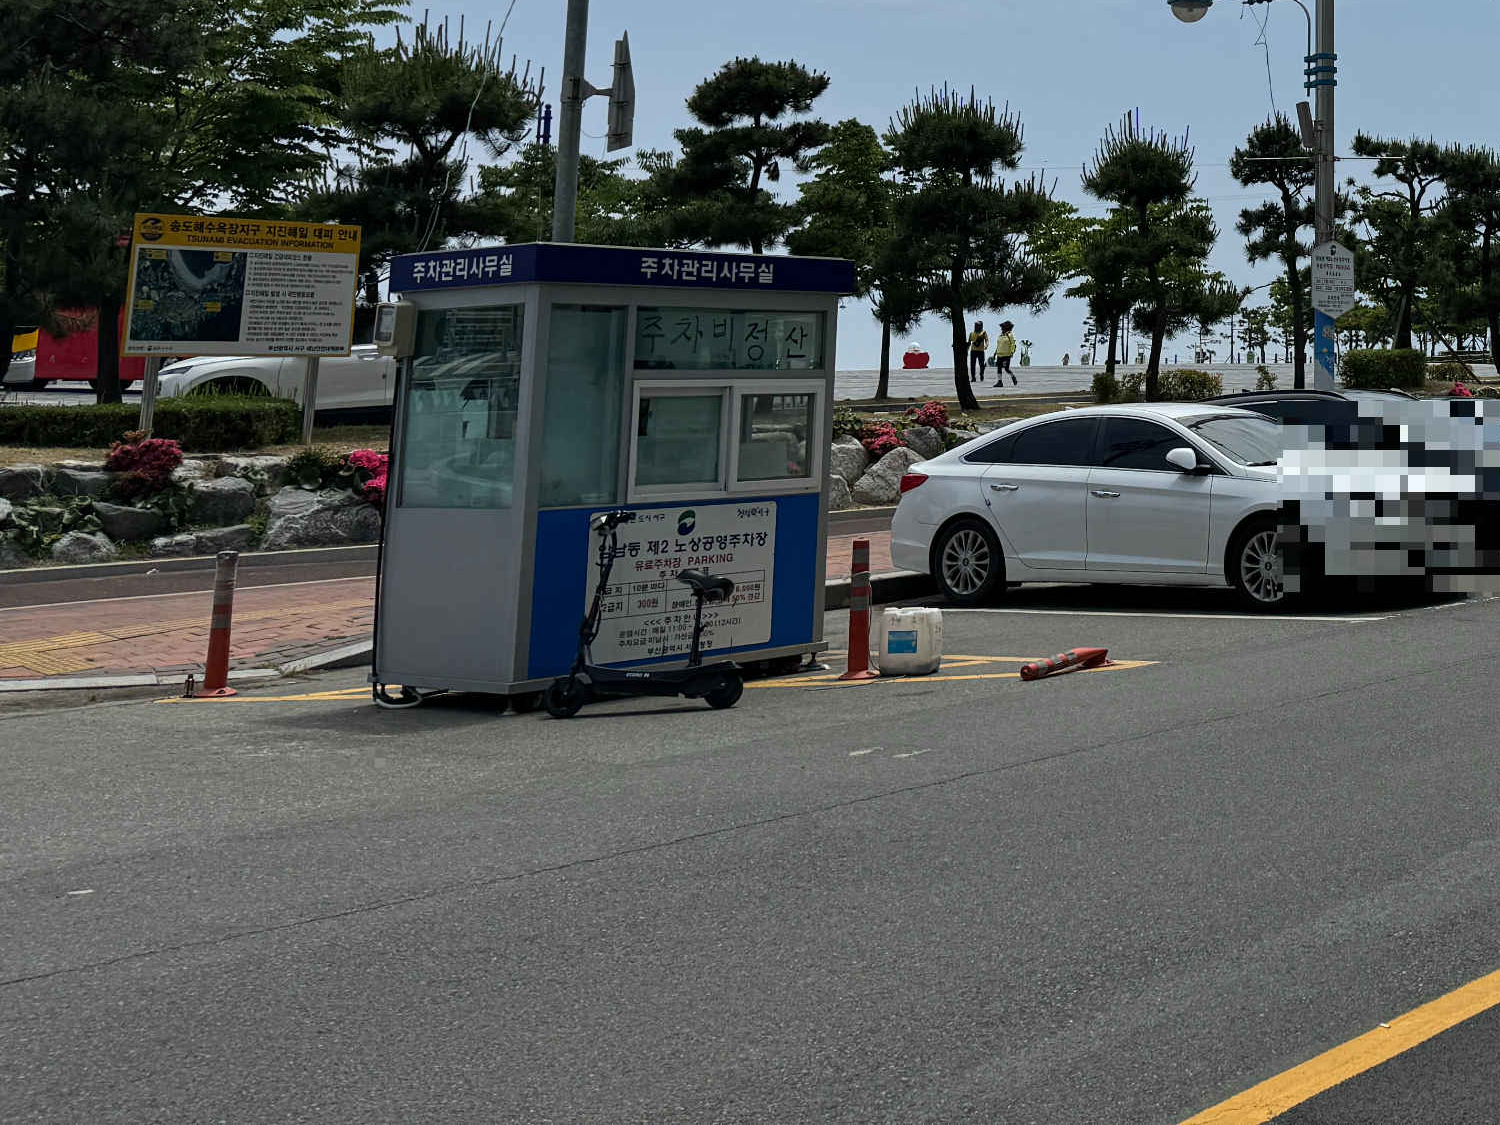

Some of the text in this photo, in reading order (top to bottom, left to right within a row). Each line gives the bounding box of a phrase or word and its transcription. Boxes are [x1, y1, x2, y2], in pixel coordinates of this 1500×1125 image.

[170, 220, 359, 242] 송도해수욕장지구 지진해일 대피 안내
[187, 235, 334, 249] TSUNAMI EVACUATION INFORMATION
[412, 253, 514, 284] 주차관리사무실
[640, 257, 775, 285] 주차관리사무실
[653, 513, 666, 522] 서구
[646, 539, 669, 556] 제2
[674, 531, 768, 553] 노상공영주차장
[634, 553, 734, 572] 유료주차장 PARKING
[632, 584, 649, 592] 10분
[651, 582, 665, 591] 마다
[602, 597, 659, 613] 2급지 300원
